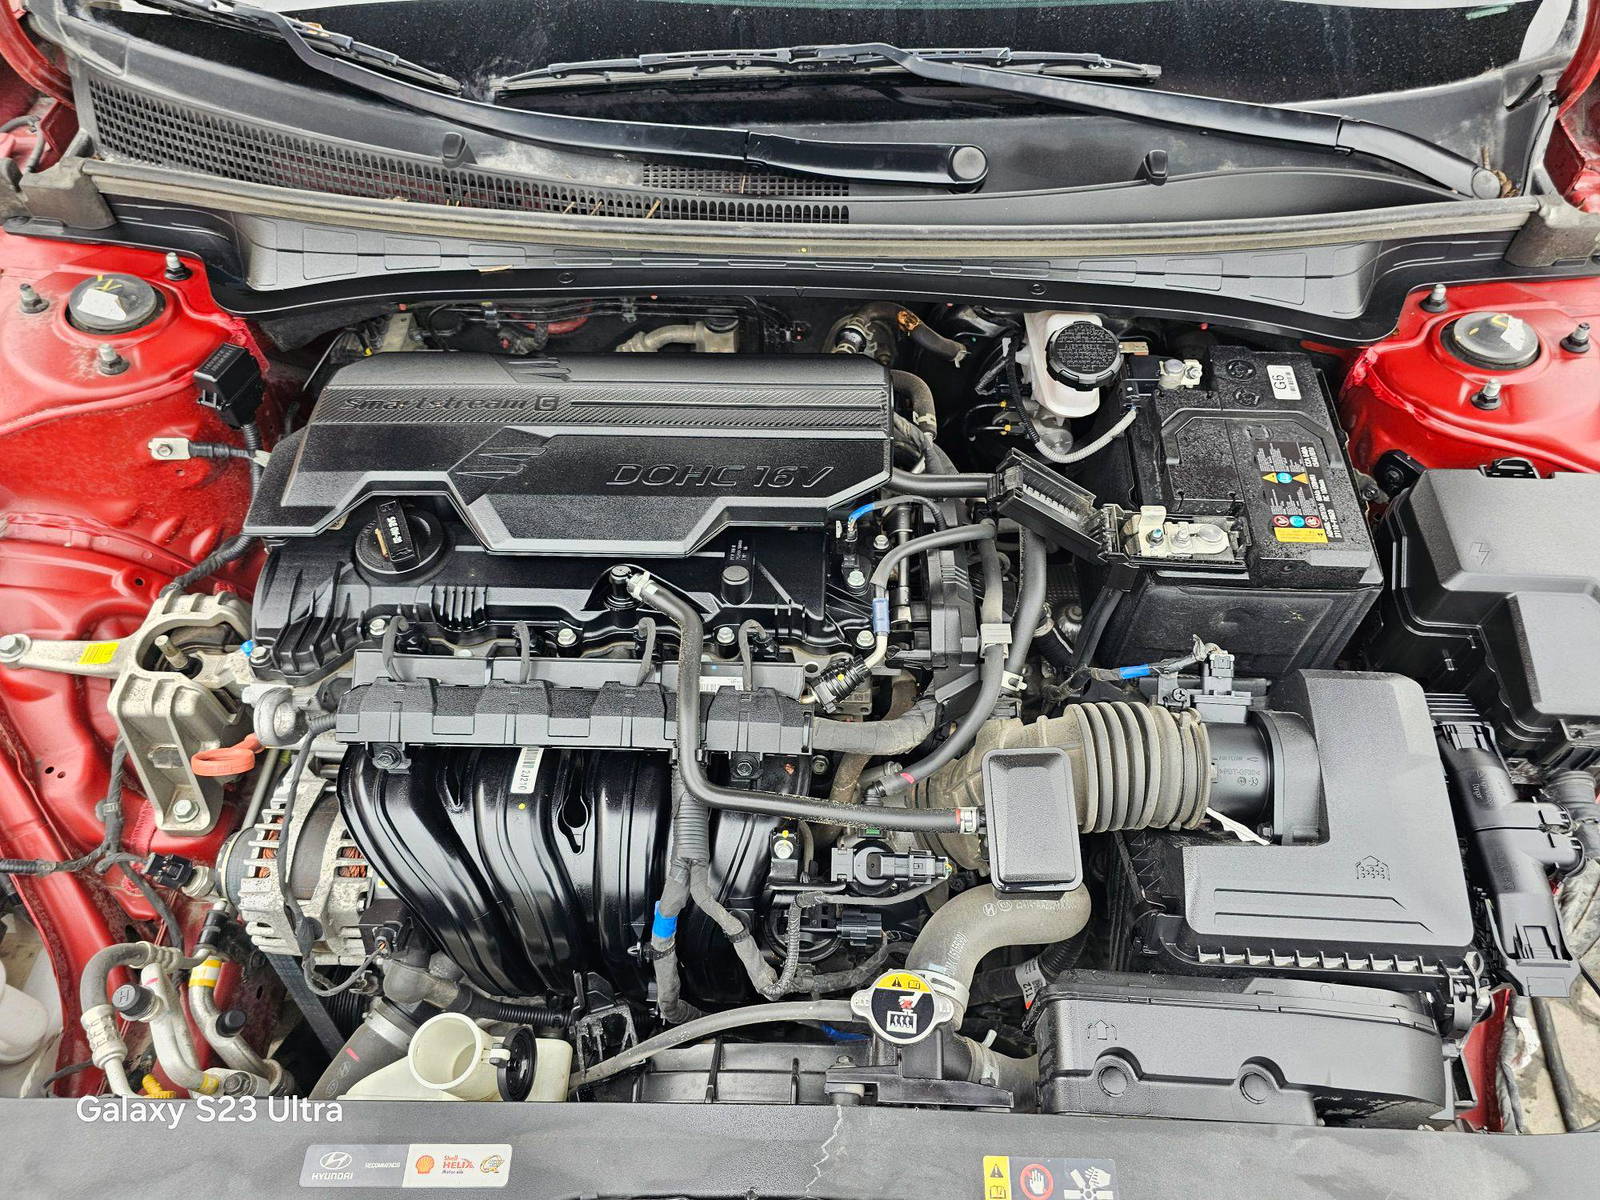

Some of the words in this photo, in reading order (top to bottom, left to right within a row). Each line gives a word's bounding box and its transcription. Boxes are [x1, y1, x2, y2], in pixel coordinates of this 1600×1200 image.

[1272, 374, 1286, 389] G6
[340, 396, 528, 411] Smartstream
[606, 463, 746, 487] DOHC
[753, 465, 834, 488] 16V
[442, 1161, 475, 1169] HELIX
[311, 1171, 354, 1181] HYUNDAI
